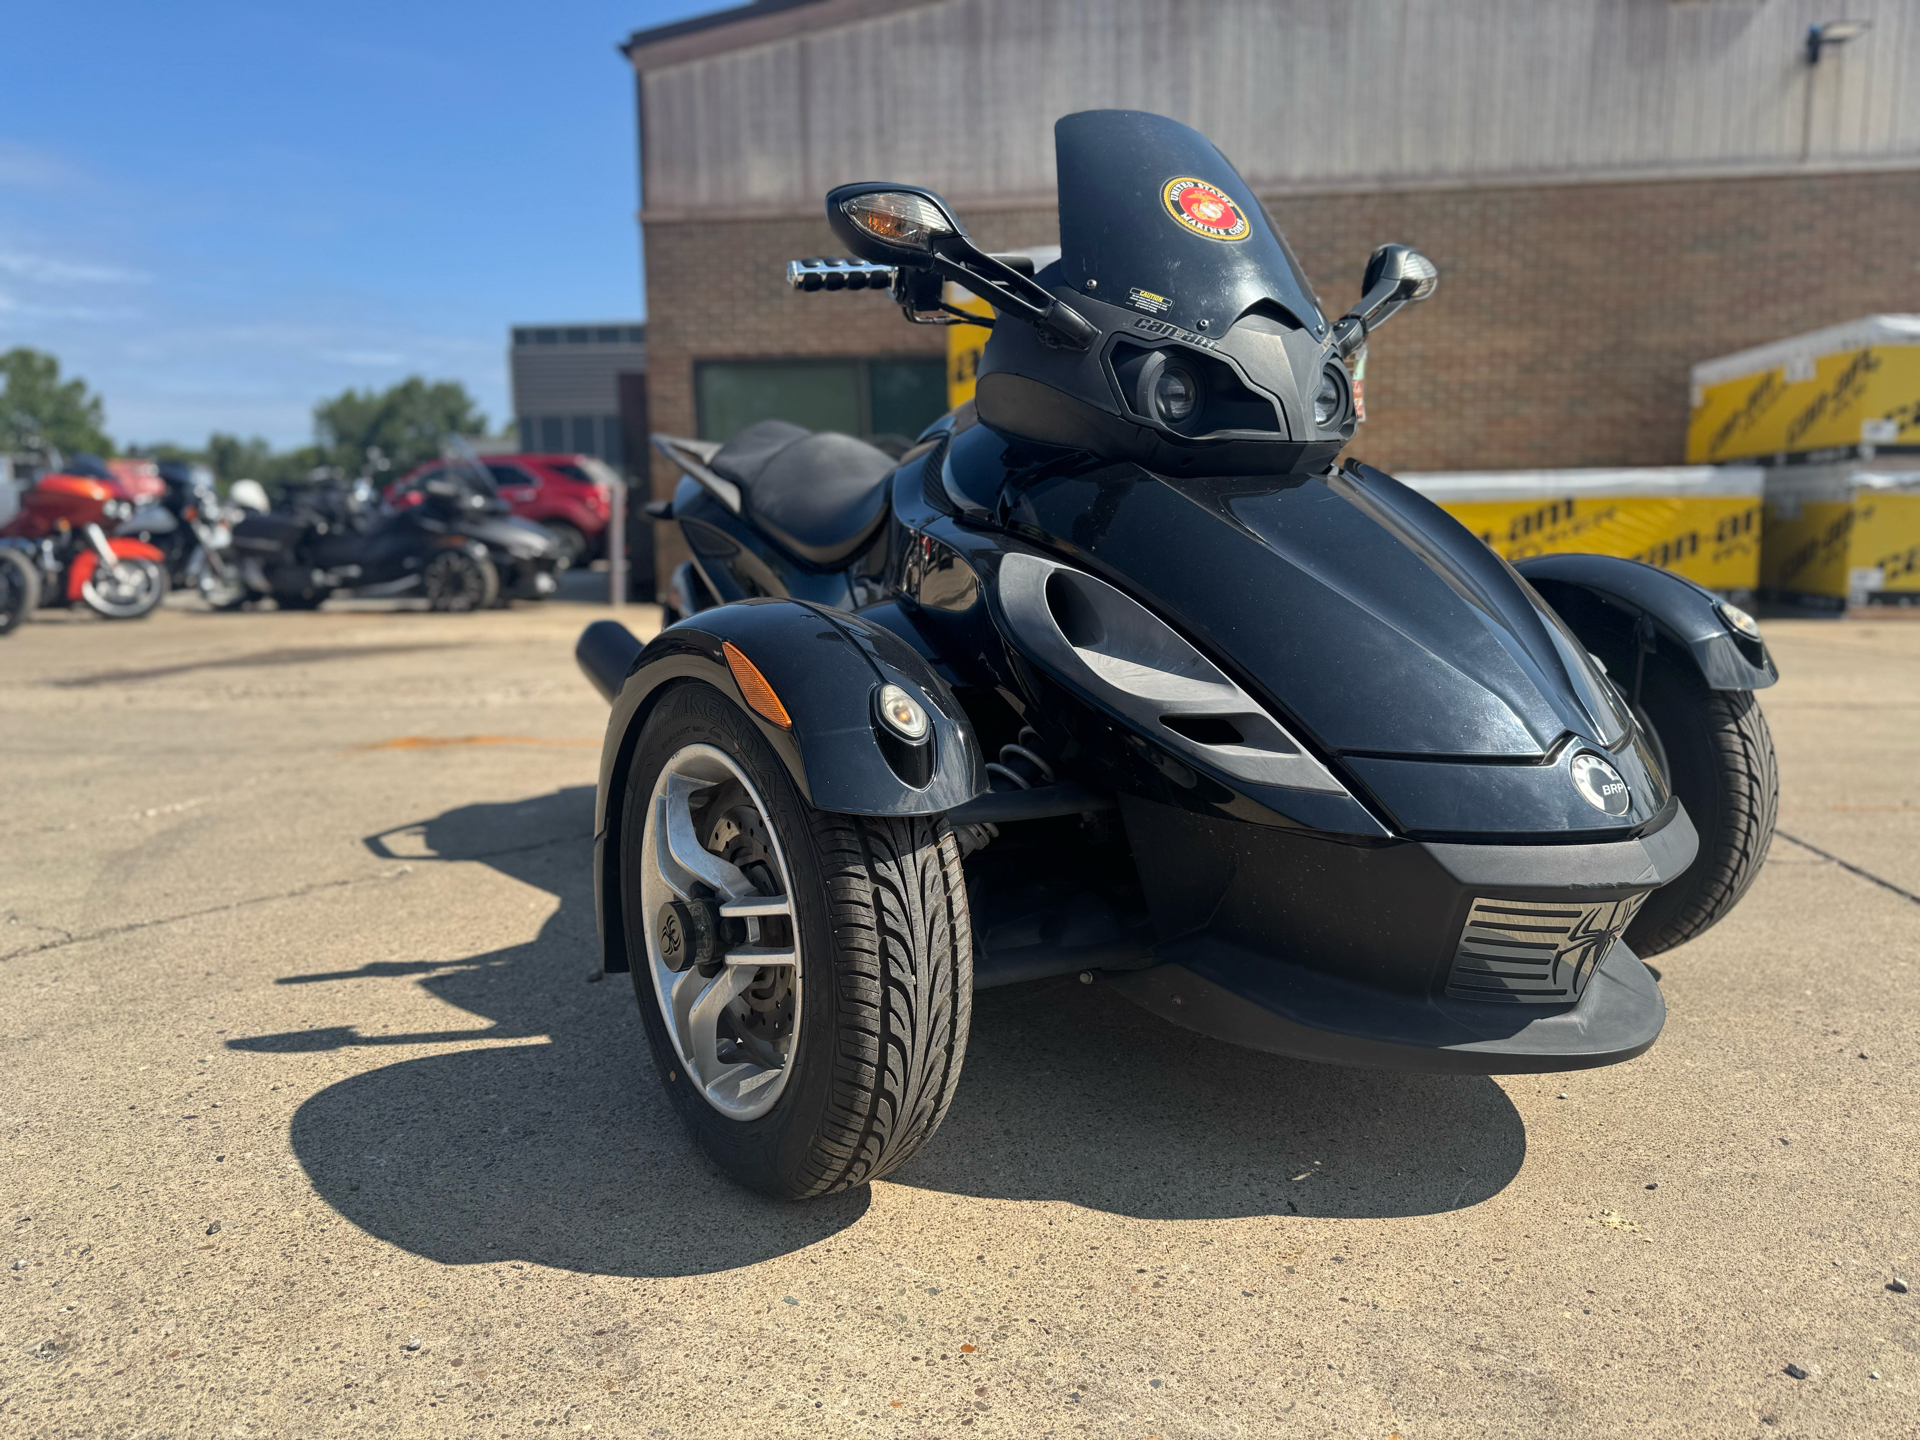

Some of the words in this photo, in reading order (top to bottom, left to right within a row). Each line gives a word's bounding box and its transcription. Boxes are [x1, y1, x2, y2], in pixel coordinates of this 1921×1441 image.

[1170, 181, 1194, 201] UNITED
[1197, 183, 1234, 208] STATES
[1180, 213, 1226, 236] MARINE
[1228, 218, 1245, 236] CORPS
[1140, 290, 1164, 303] CAUTION
[1602, 783, 1623, 796] BRP
